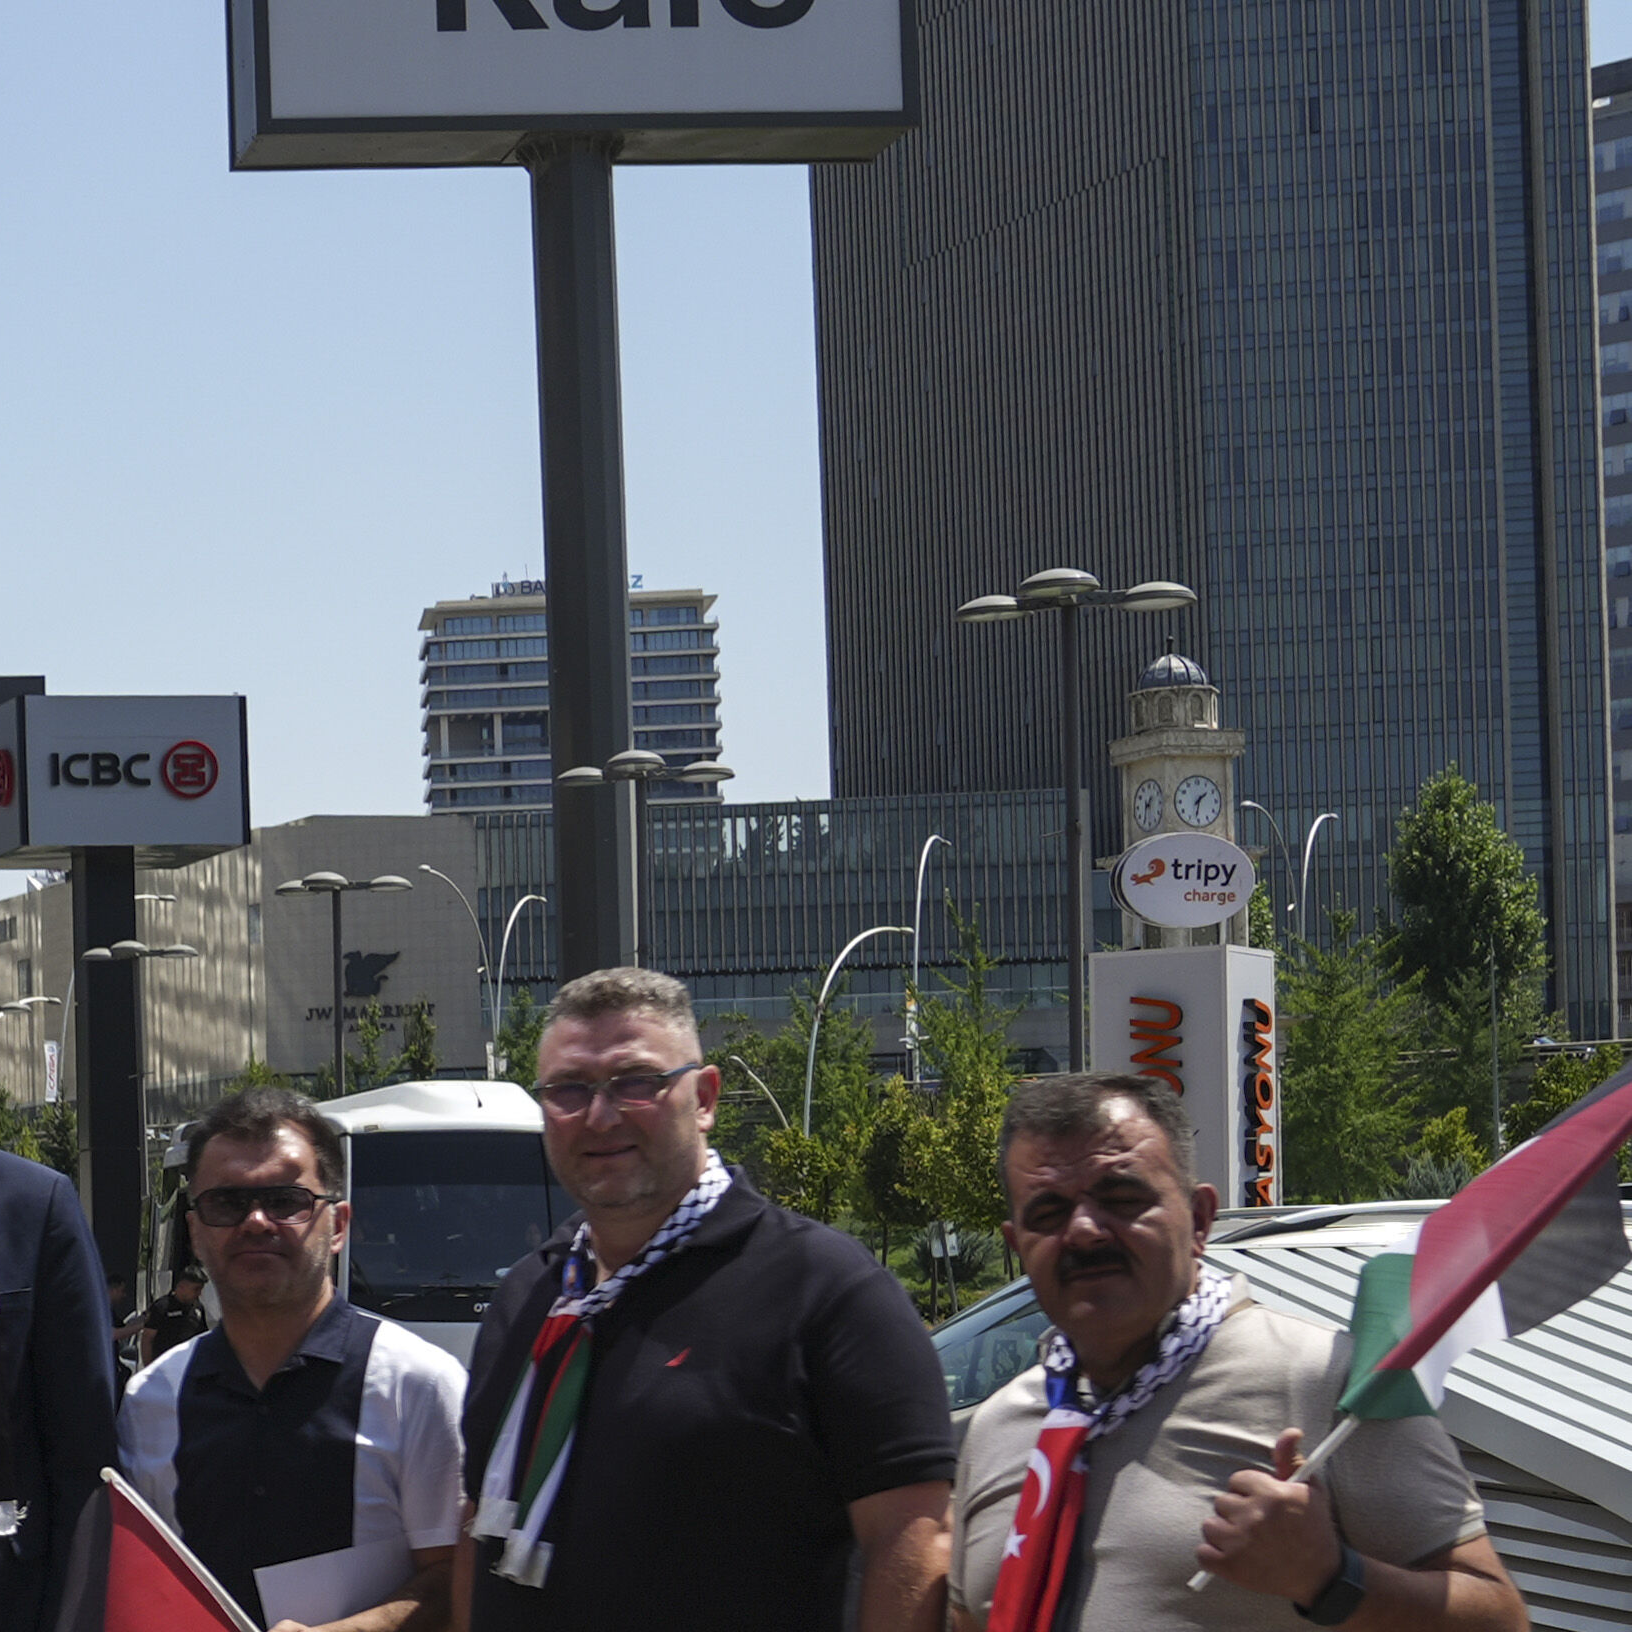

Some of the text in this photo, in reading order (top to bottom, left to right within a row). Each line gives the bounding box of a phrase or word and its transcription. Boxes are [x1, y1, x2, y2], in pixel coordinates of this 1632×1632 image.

[50, 752, 151, 787] ICBC
[1171, 858, 1237, 886] tripy
[1184, 889, 1236, 905] charge
[305, 1006, 333, 1022] JW
